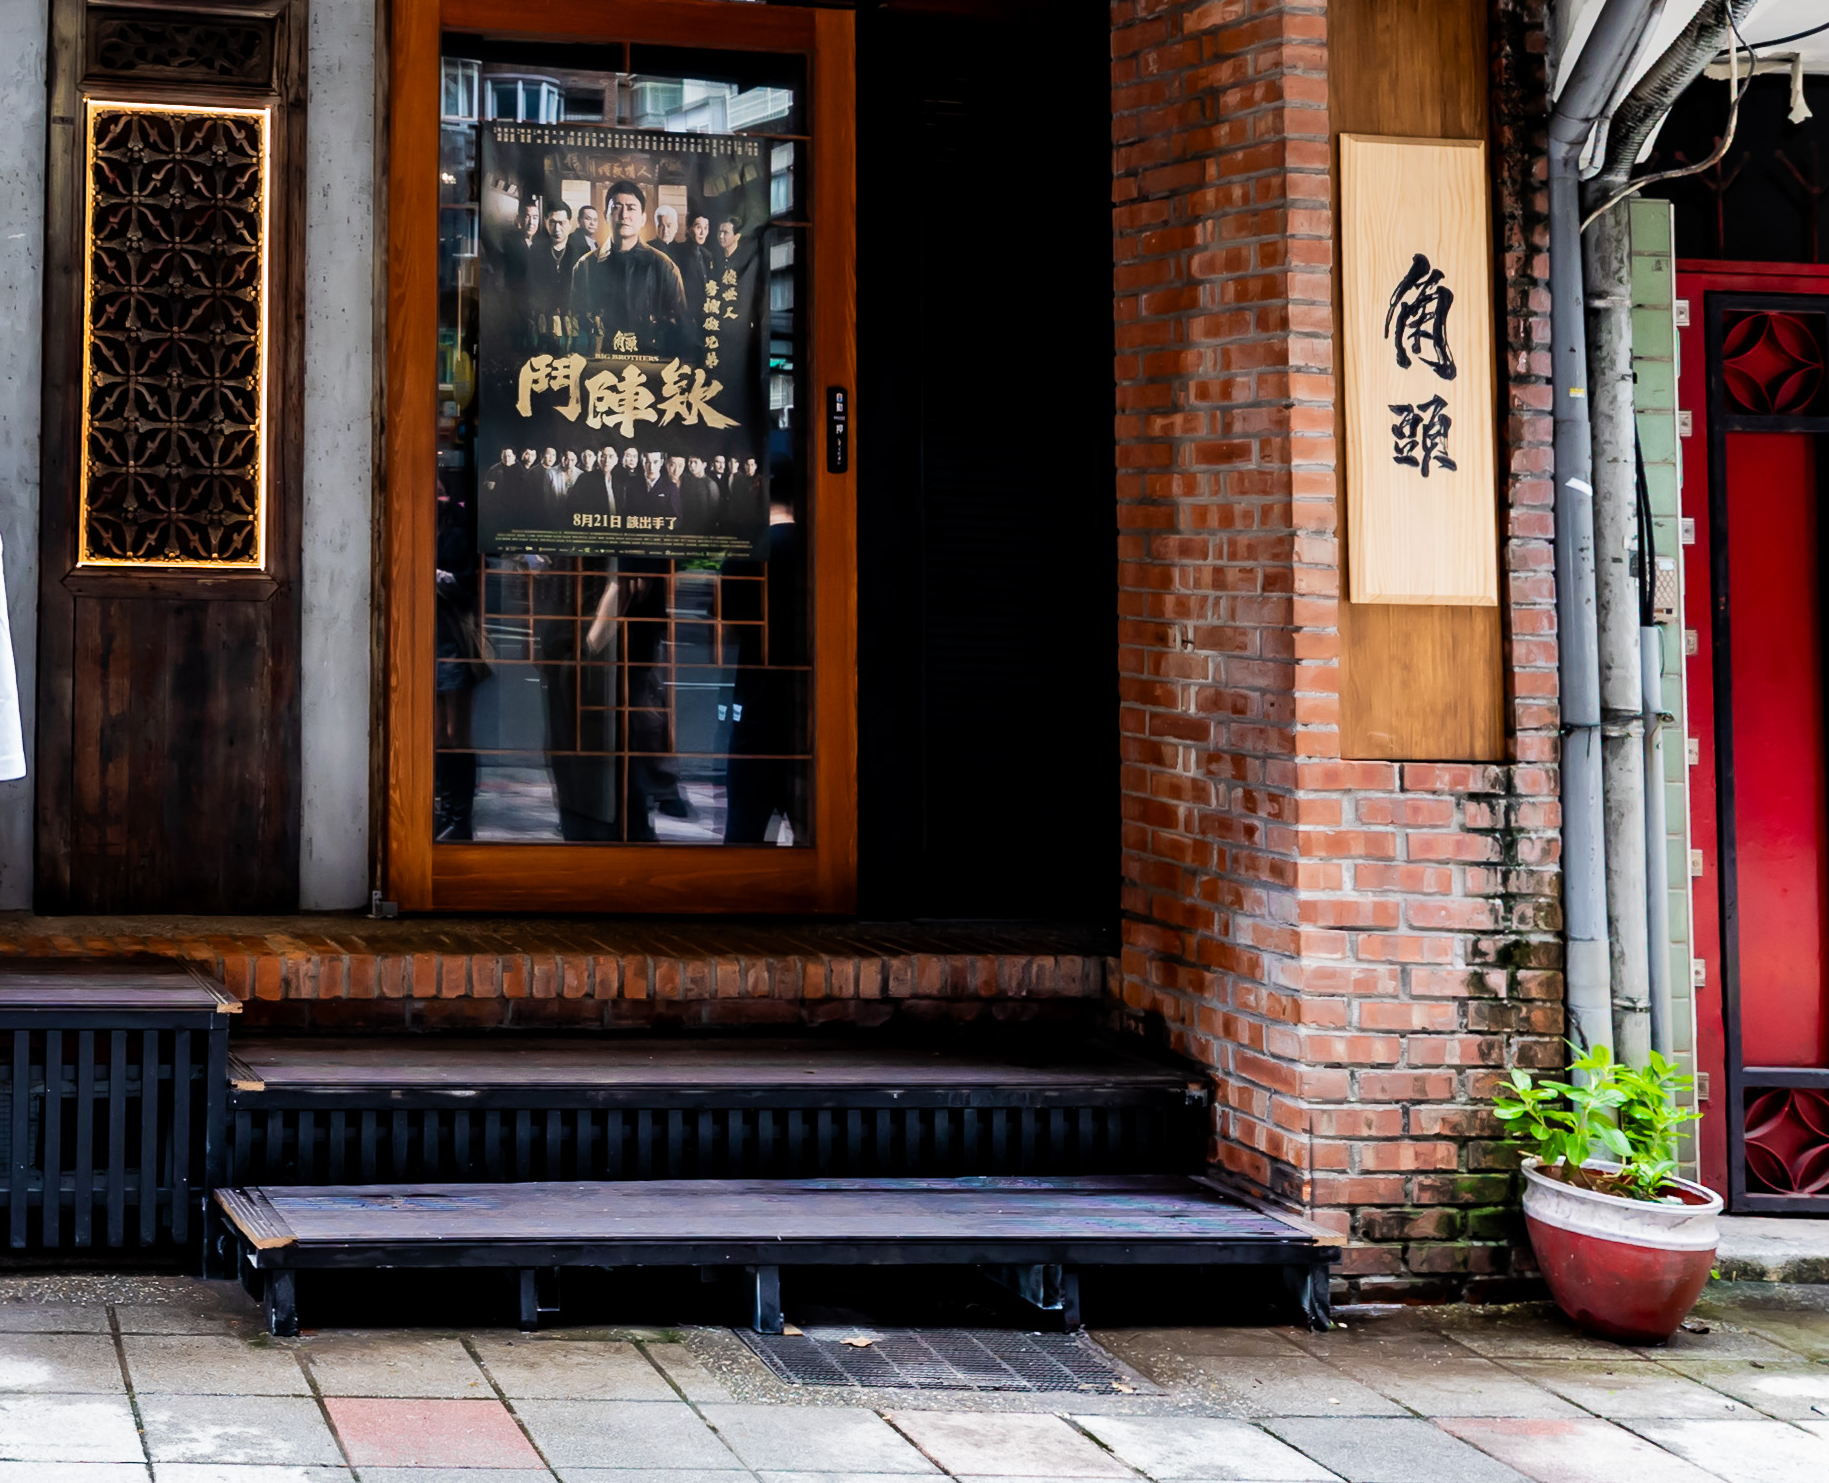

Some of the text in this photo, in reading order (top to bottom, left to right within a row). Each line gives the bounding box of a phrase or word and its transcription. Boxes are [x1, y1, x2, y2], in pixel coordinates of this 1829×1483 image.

[1384, 253, 1458, 478] 角頭
[572, 513, 678, 530] 8月21日 該出手了
